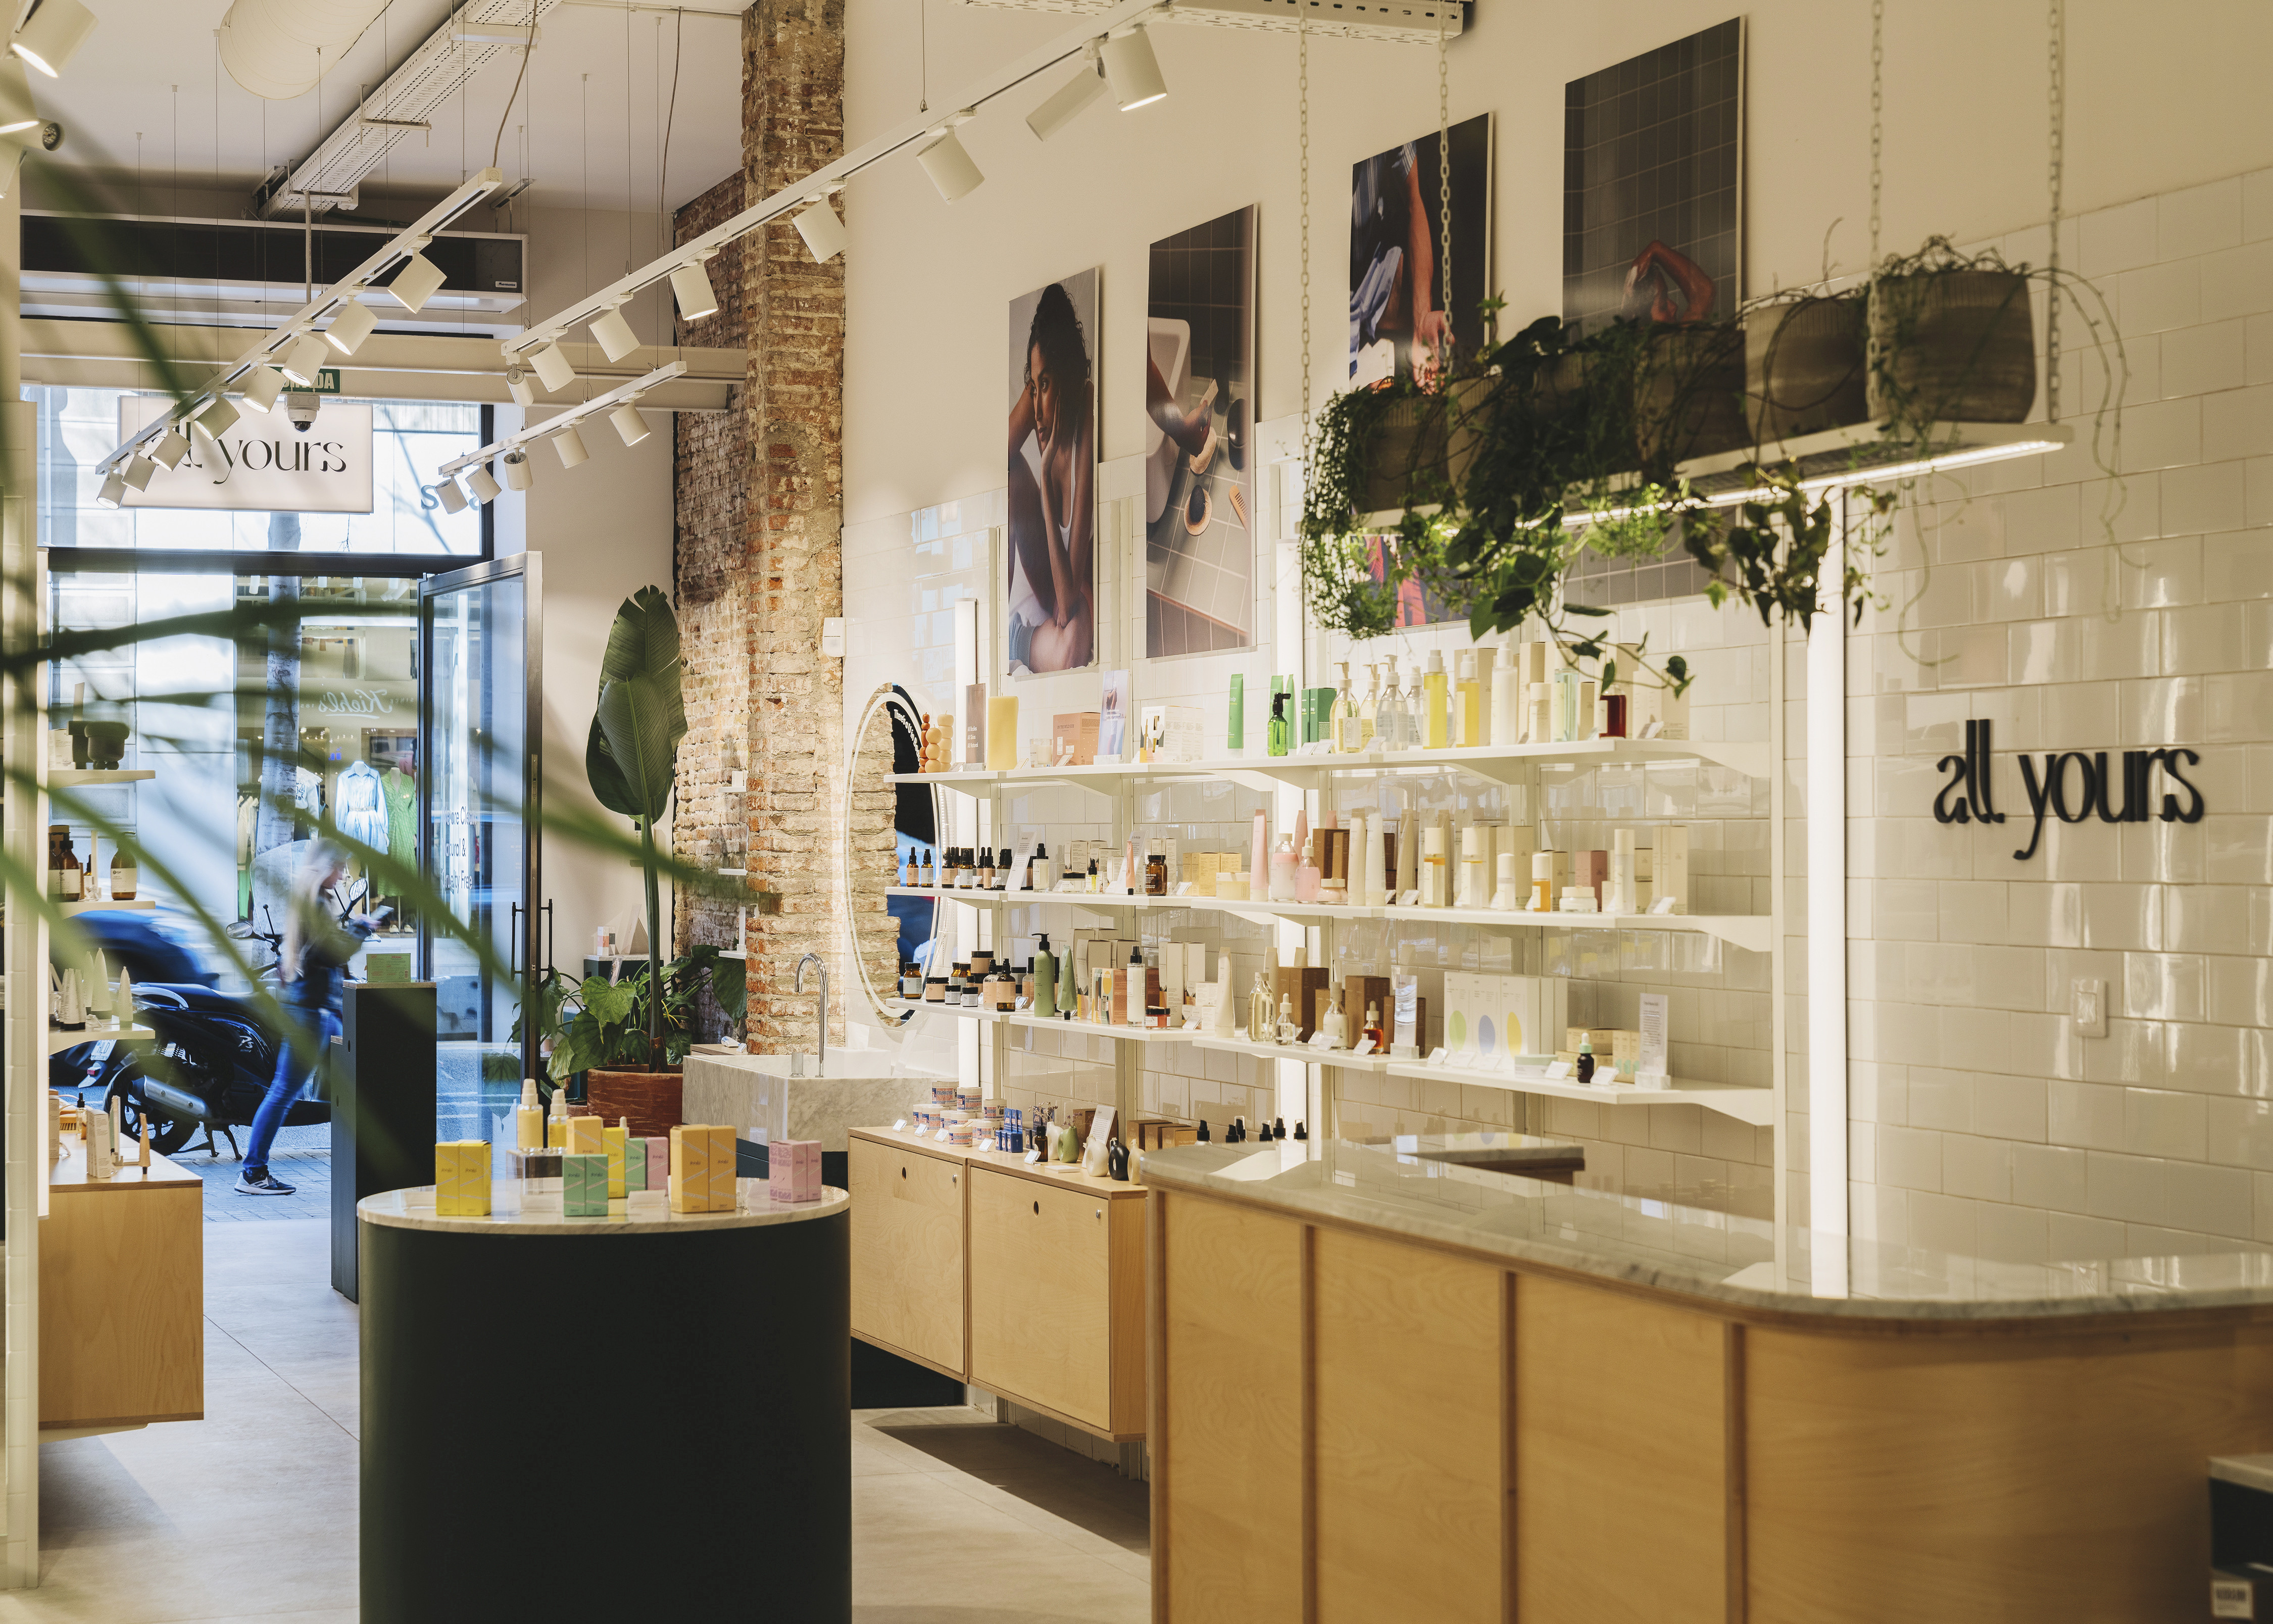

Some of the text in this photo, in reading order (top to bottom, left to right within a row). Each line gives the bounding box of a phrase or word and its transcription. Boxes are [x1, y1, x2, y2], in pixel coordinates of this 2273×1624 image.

[213, 439, 347, 484] yours
[1934, 719, 2204, 860] all yours
[451, 811, 459, 825] are
[462, 838, 466, 857] &
[461, 870, 473, 890] Free
